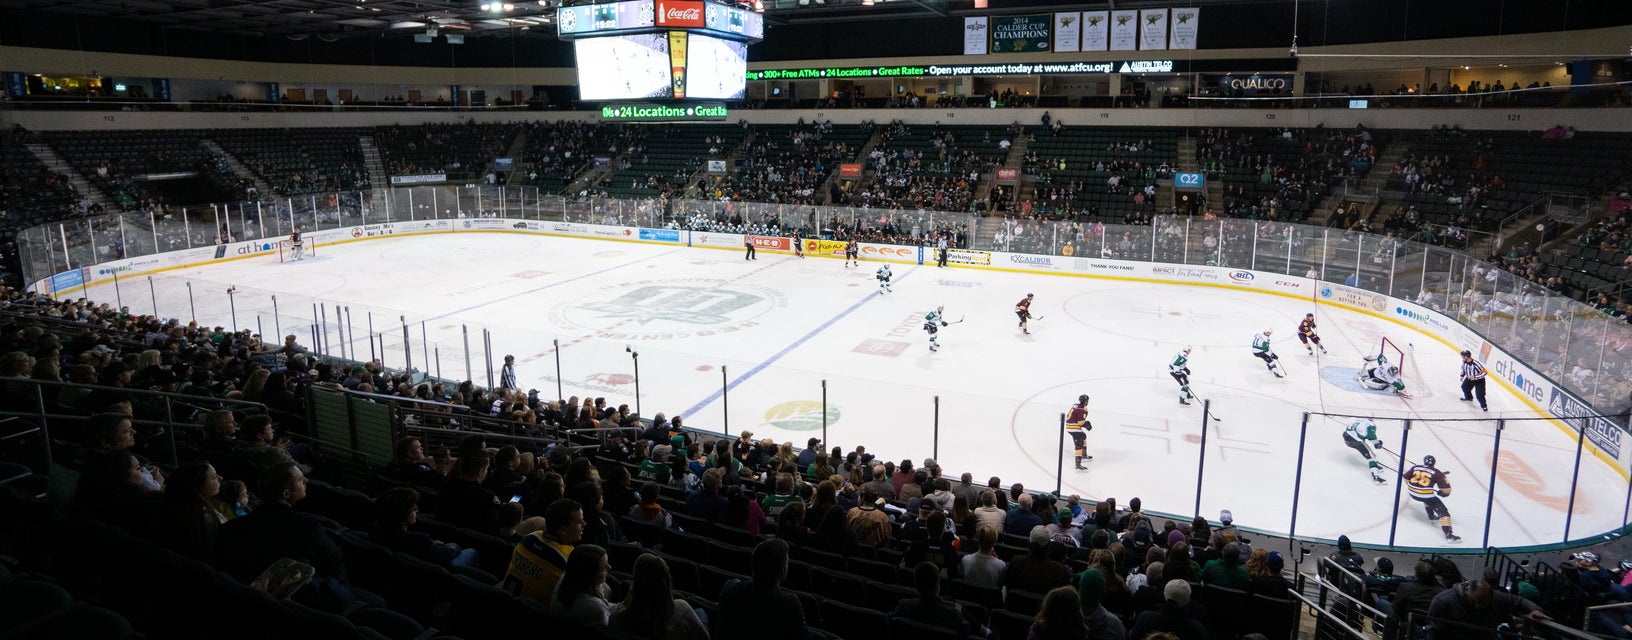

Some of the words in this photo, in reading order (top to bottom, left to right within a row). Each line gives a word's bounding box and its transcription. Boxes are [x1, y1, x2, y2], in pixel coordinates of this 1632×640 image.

[994, 30, 1048, 39] CHAMPIONS
[764, 70, 781, 78] 300+
[799, 69, 819, 77] ATMs
[837, 68, 871, 76] Locations
[879, 67, 900, 76] Great
[930, 66, 952, 76] Open
[953, 66, 972, 76] your
[973, 65, 1006, 74] account
[1007, 64, 1032, 74] today
[1044, 62, 1113, 74] www.atfcu.org!
[1231, 78, 1285, 89] QUALICO
[620, 107, 632, 117] 24
[633, 106, 684, 117] Locations
[695, 105, 718, 116] Great
[1180, 174, 1198, 184] Q2
[238, 244, 252, 254] at
[1010, 254, 1052, 264] EXCALIBUR
[1496, 360, 1508, 377] at
[1594, 418, 1620, 446] TELCO
[1410, 471, 1432, 487] 26
